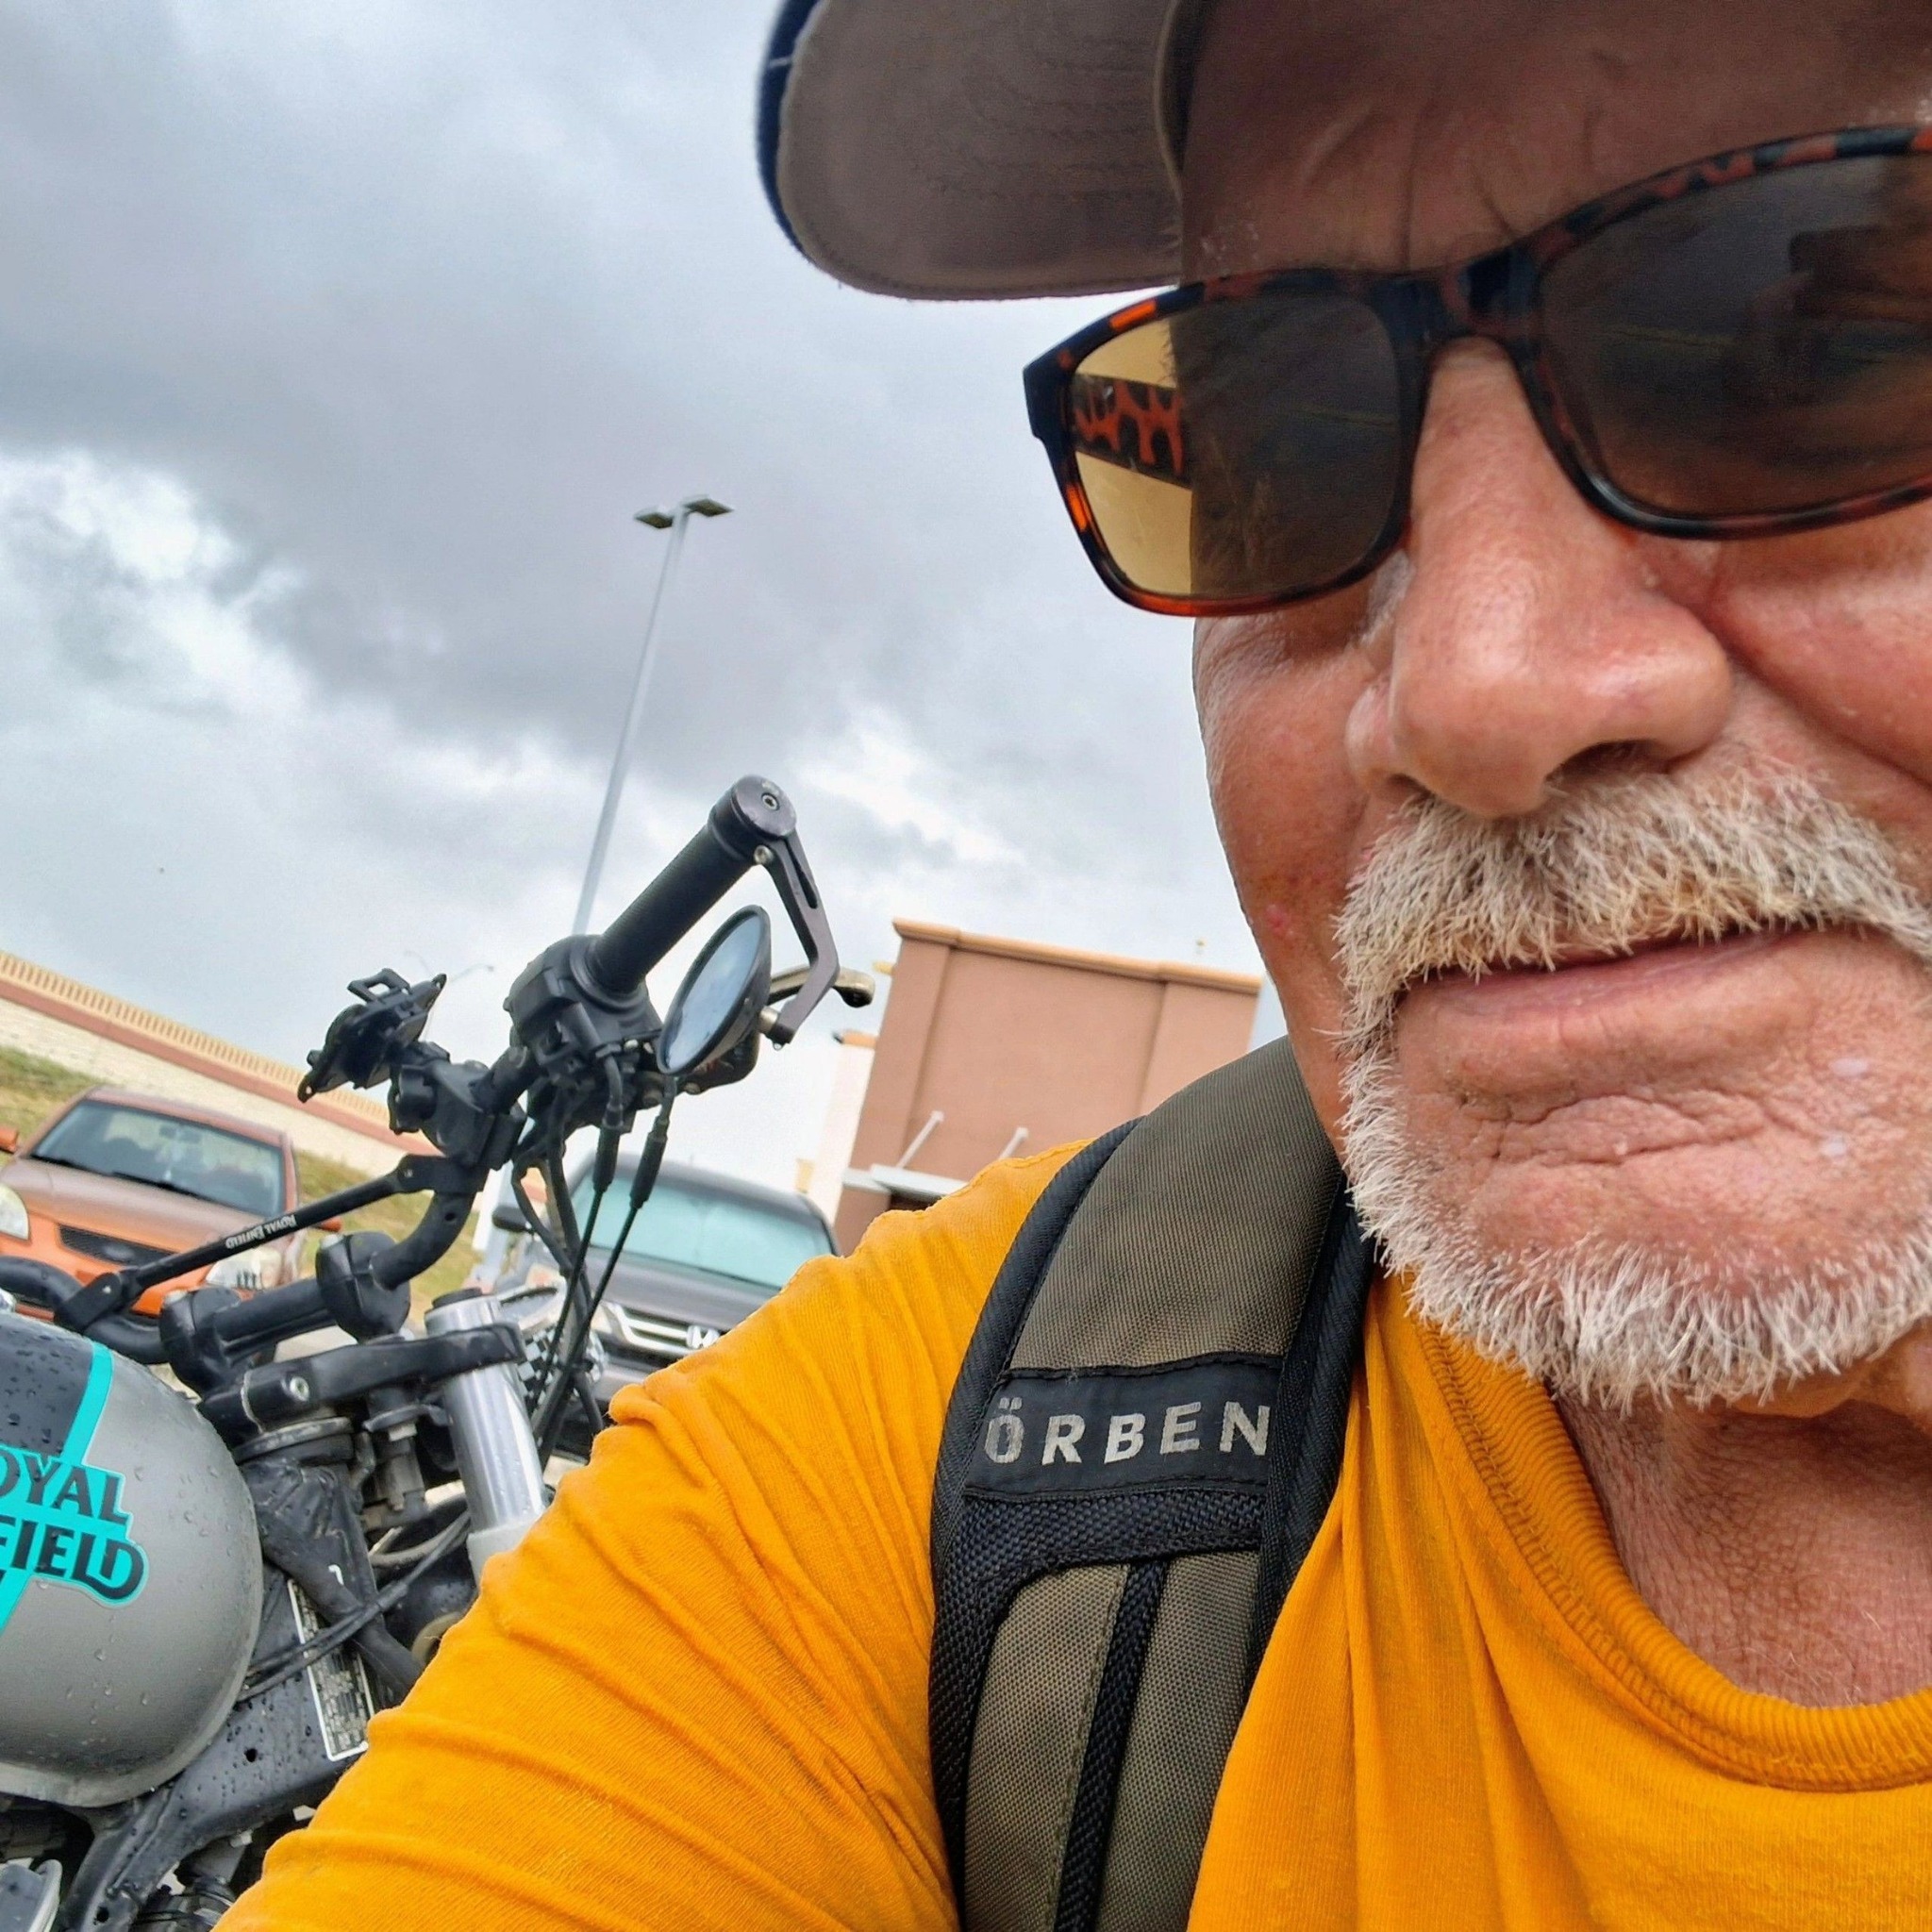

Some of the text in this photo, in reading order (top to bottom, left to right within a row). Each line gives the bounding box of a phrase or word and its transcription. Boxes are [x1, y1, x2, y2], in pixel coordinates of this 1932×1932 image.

[226, 1215, 296, 1249] ROYAL ENFIELD
[984, 1397, 1271, 1465] ÖRBEN
